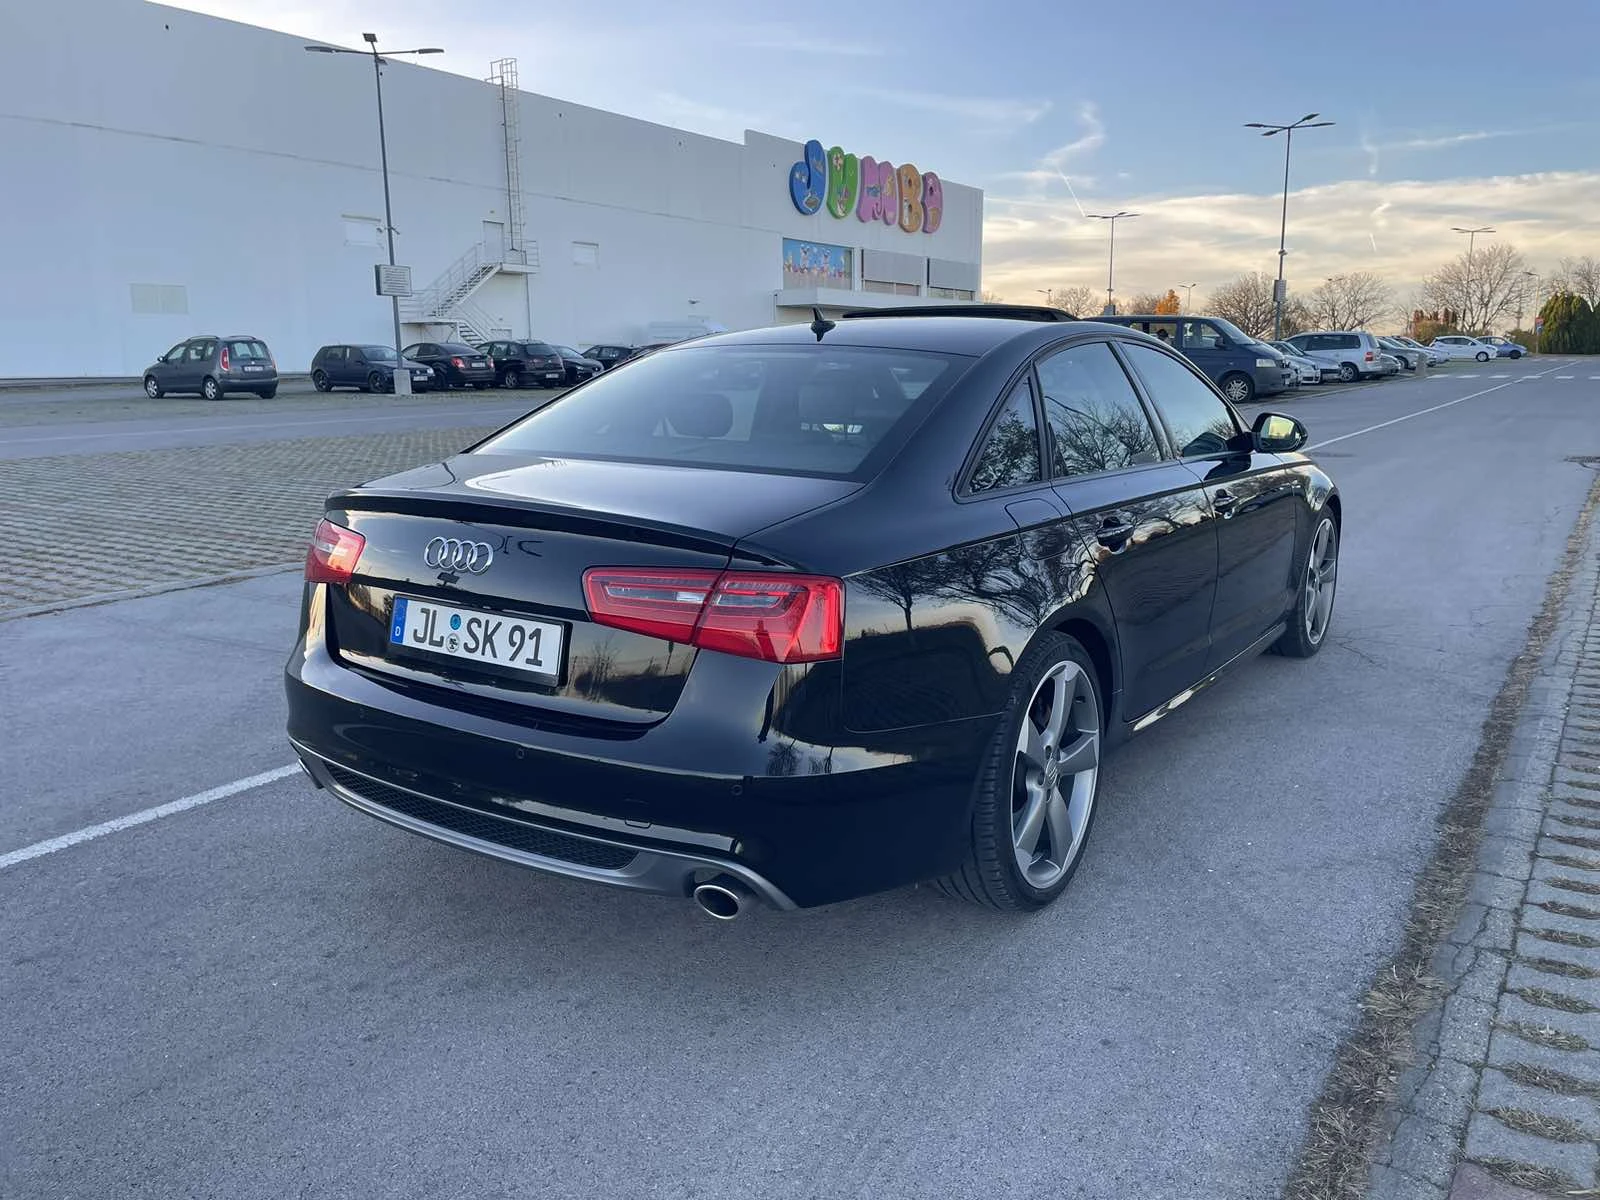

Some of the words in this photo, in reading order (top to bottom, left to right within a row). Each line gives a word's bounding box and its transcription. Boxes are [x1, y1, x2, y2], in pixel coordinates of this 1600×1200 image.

[789, 139, 943, 233] JUMBO
[413, 607, 445, 648] JL
[463, 617, 503, 658] SK
[508, 624, 543, 667] 91
